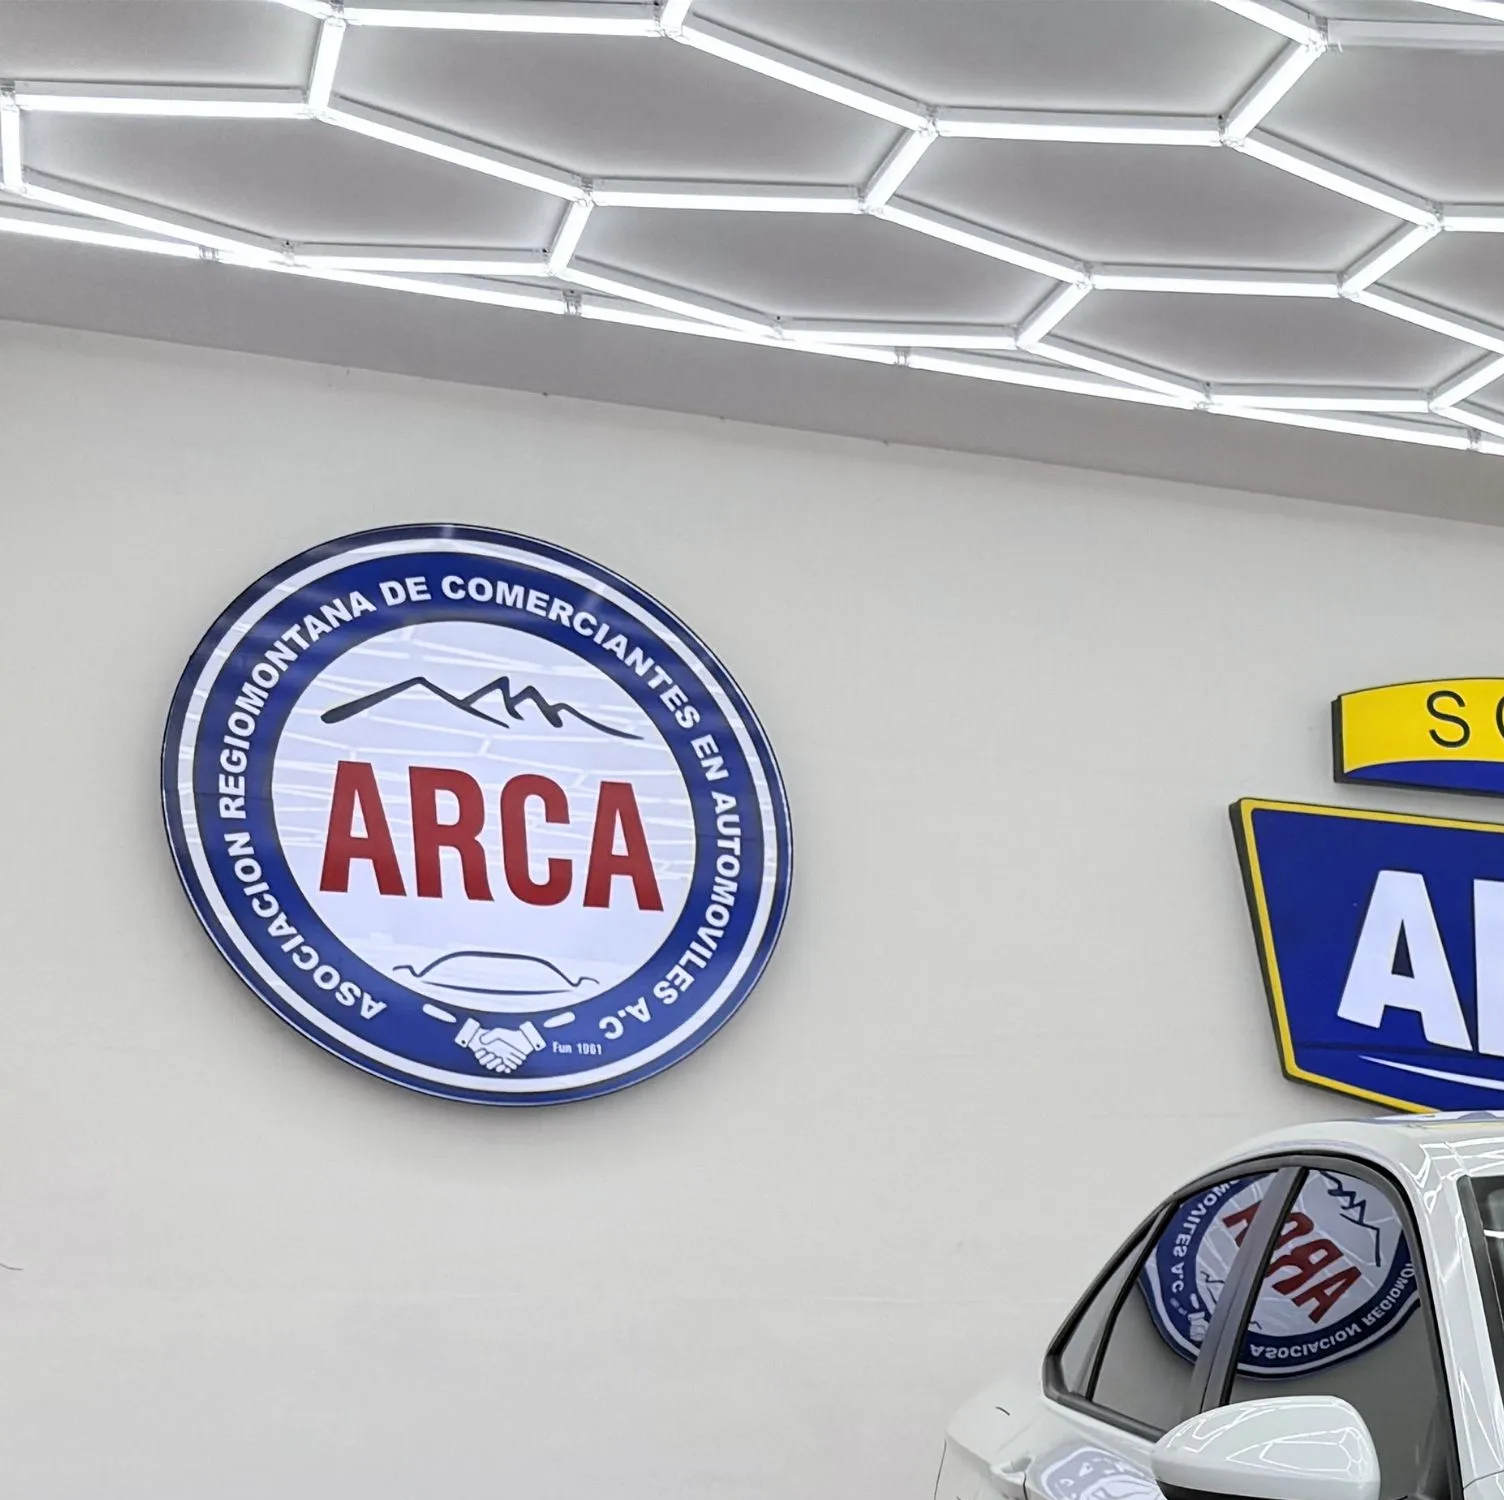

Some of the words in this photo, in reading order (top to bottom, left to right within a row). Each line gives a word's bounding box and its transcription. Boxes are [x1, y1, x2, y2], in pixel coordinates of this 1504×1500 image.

[379, 575, 432, 609] DE
[441, 575, 701, 730] COMERCIANTES
[218, 590, 377, 820] REGIOMONTANA
[691, 734, 730, 782] EN
[319, 760, 665, 913] ARCA
[660, 790, 742, 1006] AUTOMOVILES
[223, 831, 387, 1021] ASOCIACION
